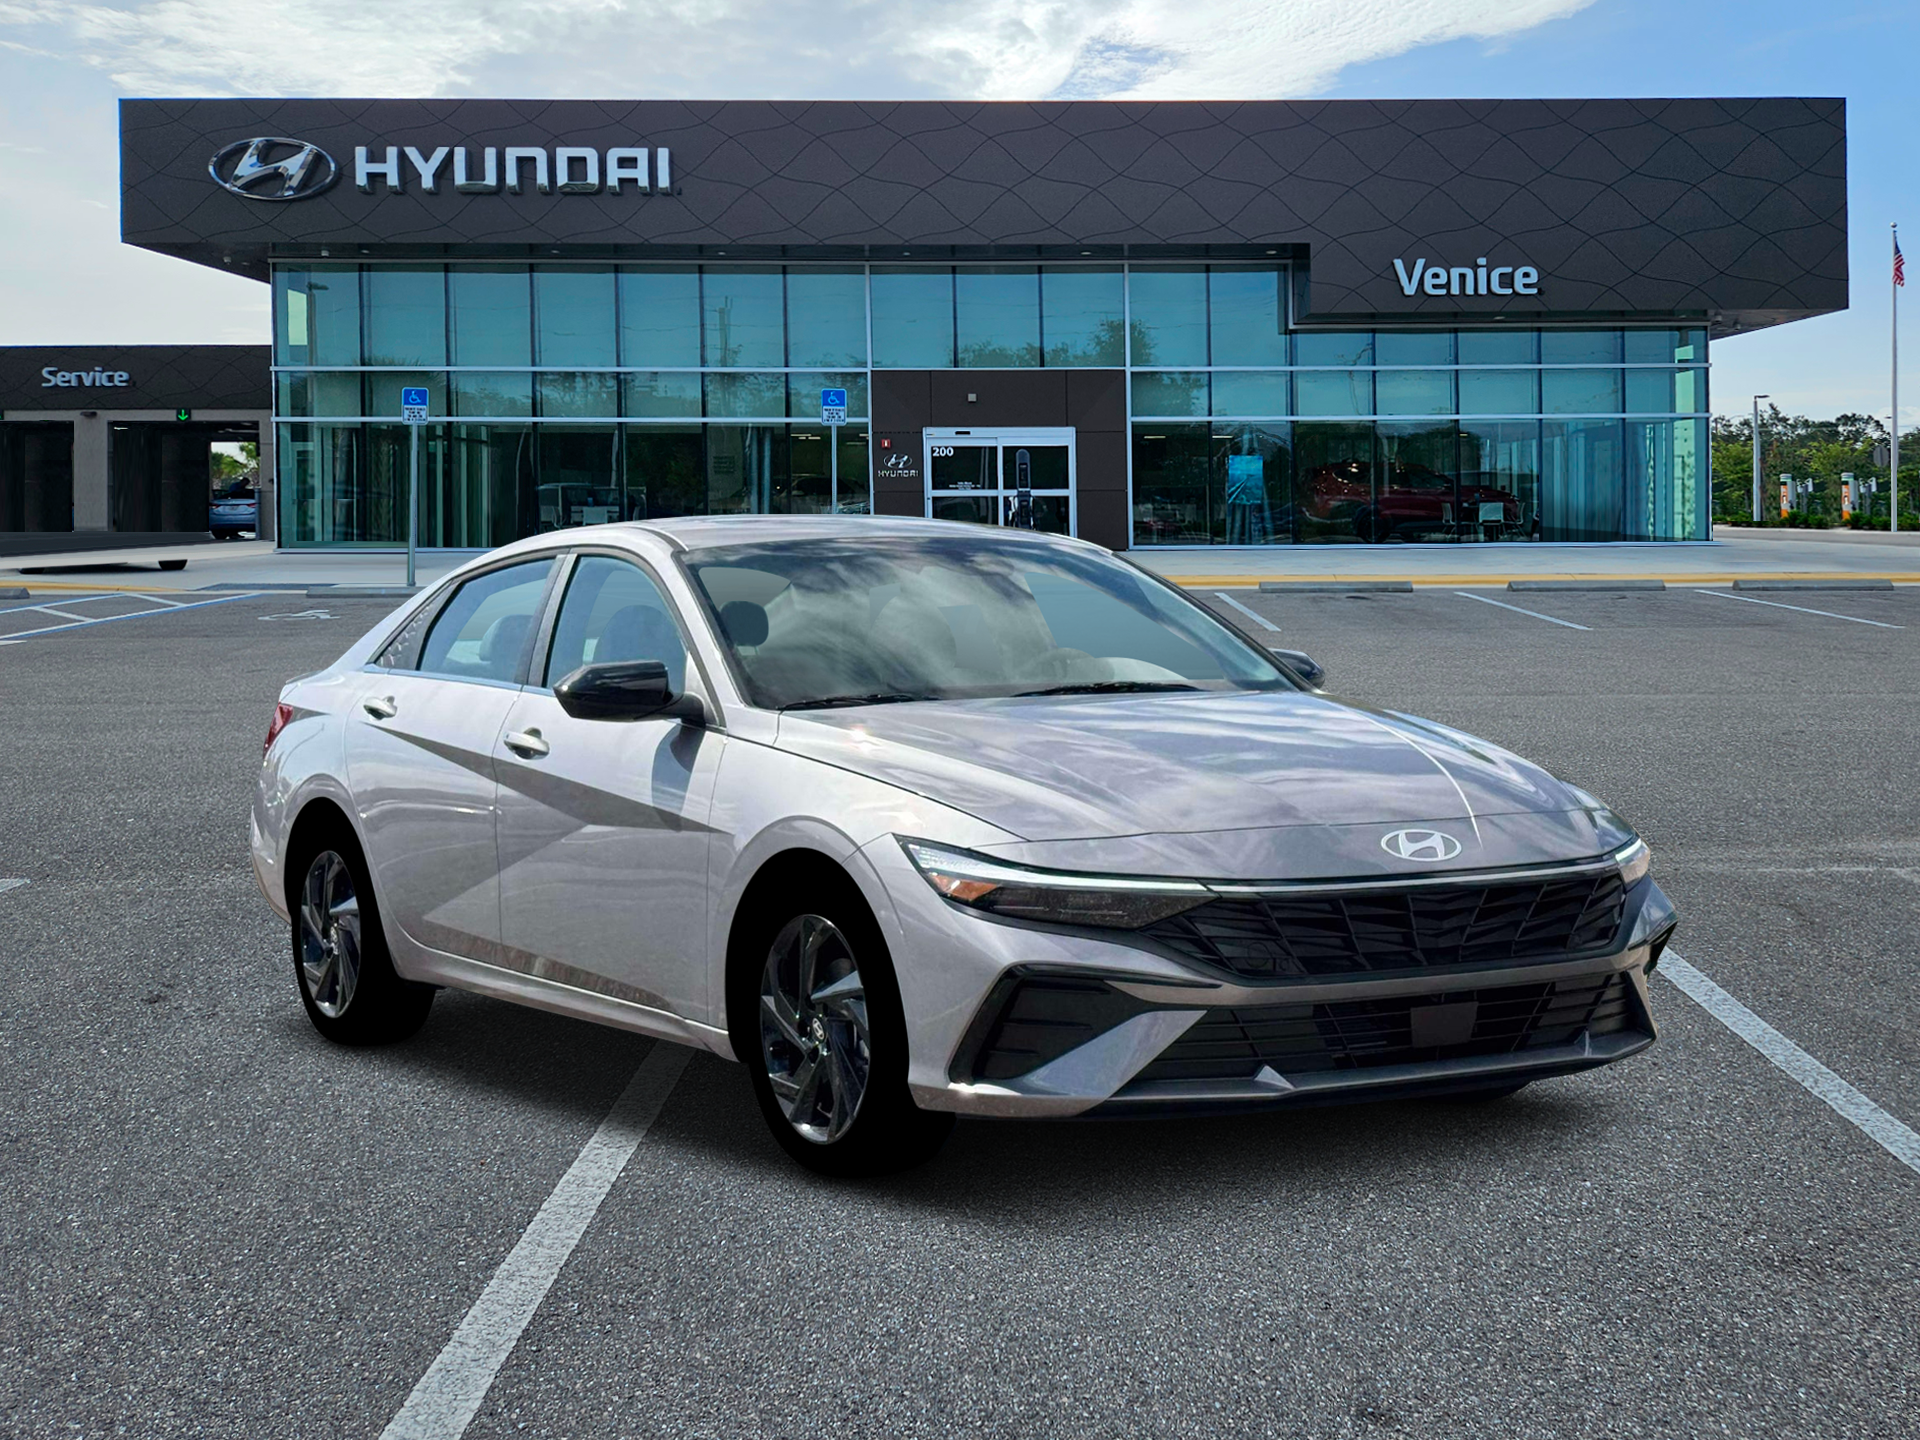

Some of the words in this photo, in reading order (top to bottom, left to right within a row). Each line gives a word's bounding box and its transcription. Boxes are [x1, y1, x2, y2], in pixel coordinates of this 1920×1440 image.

[354, 146, 670, 193] HYUNDAI
[1392, 256, 1539, 296] Venice
[41, 366, 130, 387] Service
[932, 446, 954, 457] 200
[877, 469, 919, 478] HYUNDAI
